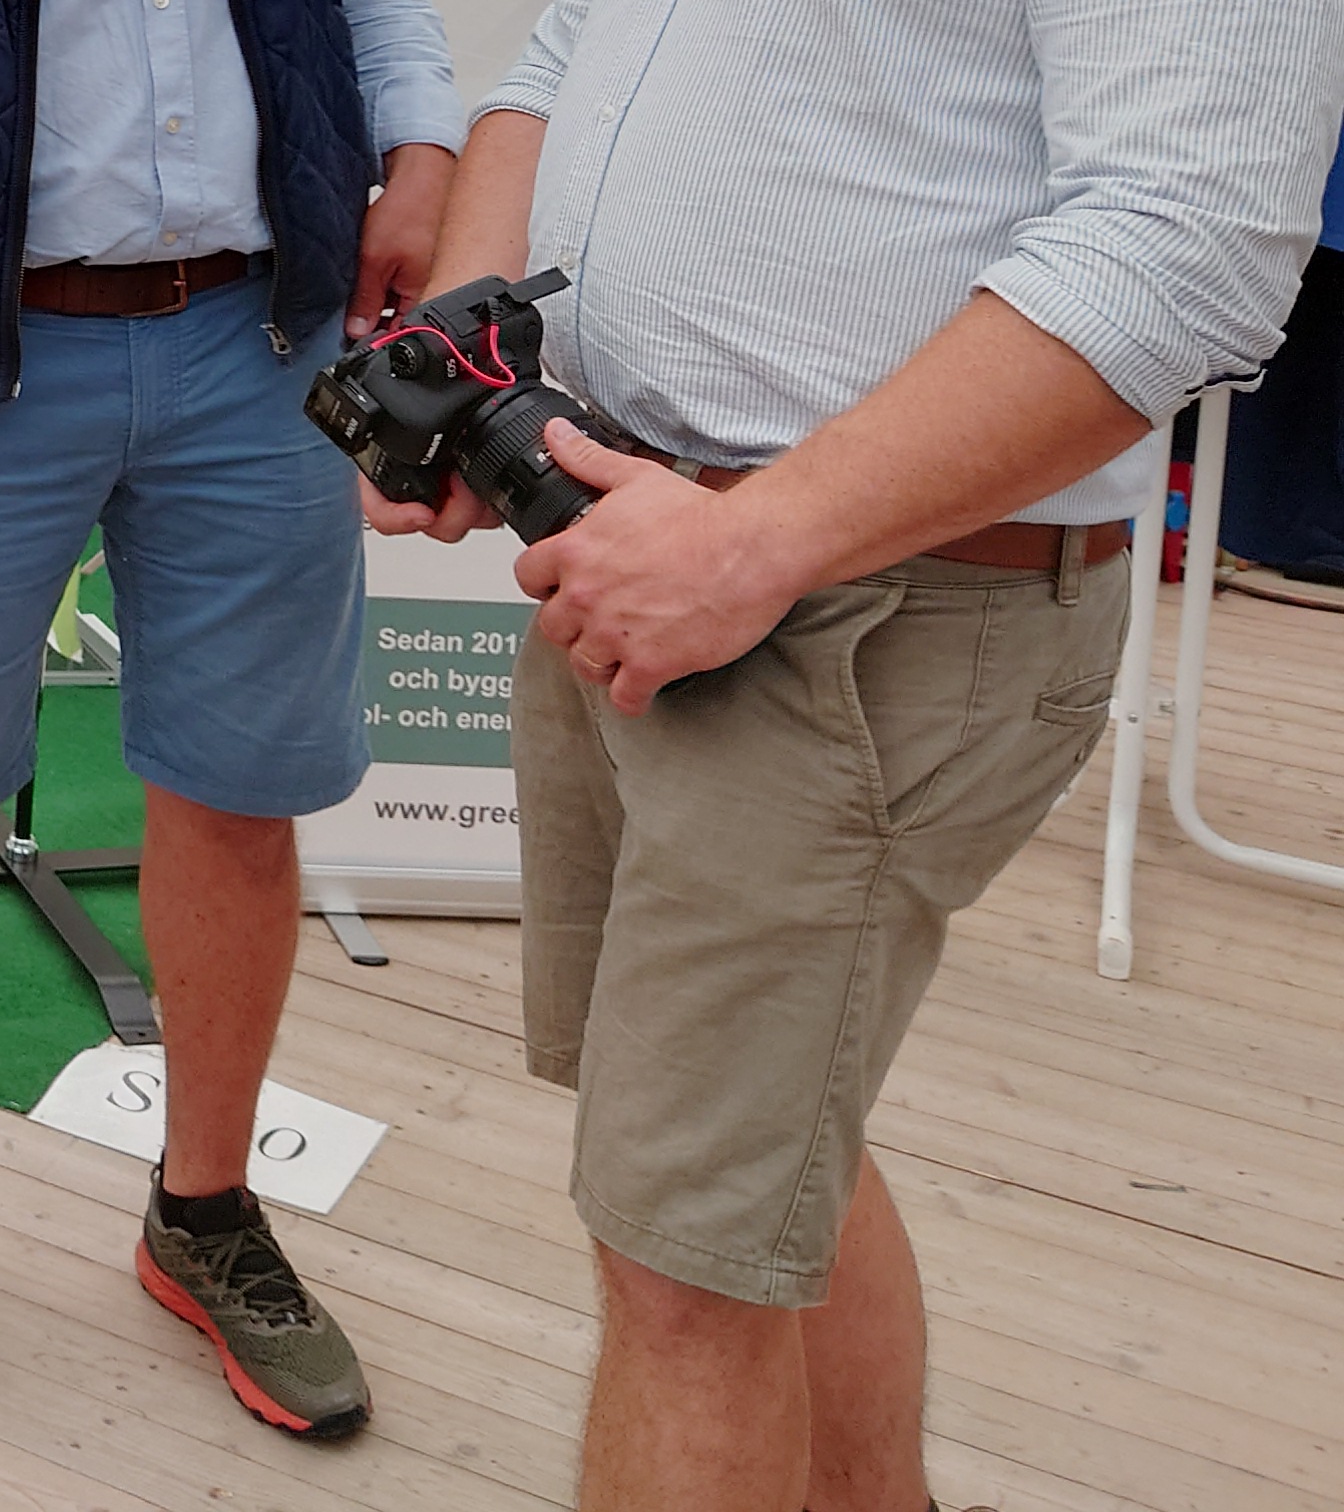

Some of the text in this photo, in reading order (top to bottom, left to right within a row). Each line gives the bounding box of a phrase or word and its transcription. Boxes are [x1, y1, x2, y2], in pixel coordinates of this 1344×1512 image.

[377, 627, 463, 653] Sedan
[388, 667, 440, 691] och
[398, 705, 449, 729] och
